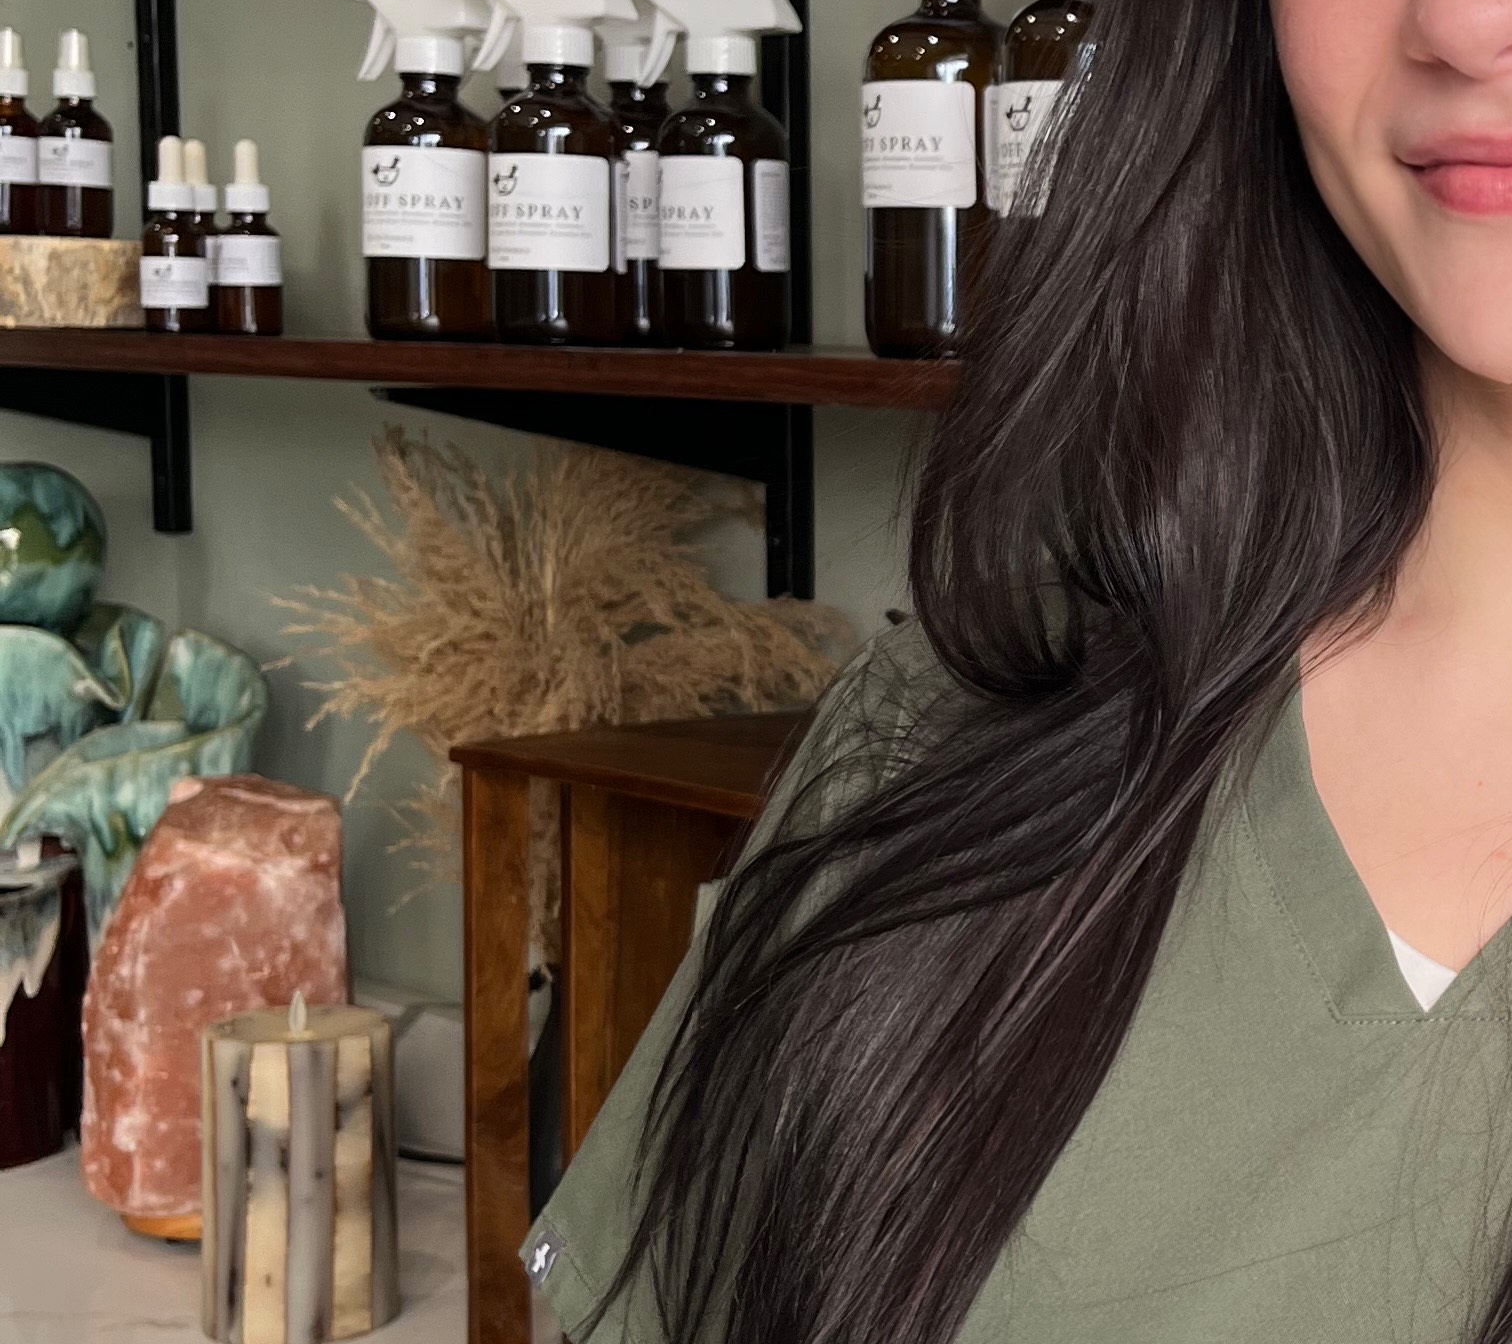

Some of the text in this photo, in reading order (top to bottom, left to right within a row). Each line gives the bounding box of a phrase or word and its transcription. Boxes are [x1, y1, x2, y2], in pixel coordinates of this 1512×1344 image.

[879, 135, 943, 152] SPRAY
[398, 192, 466, 211] SPRAY
[515, 202, 583, 221] SPRAY
